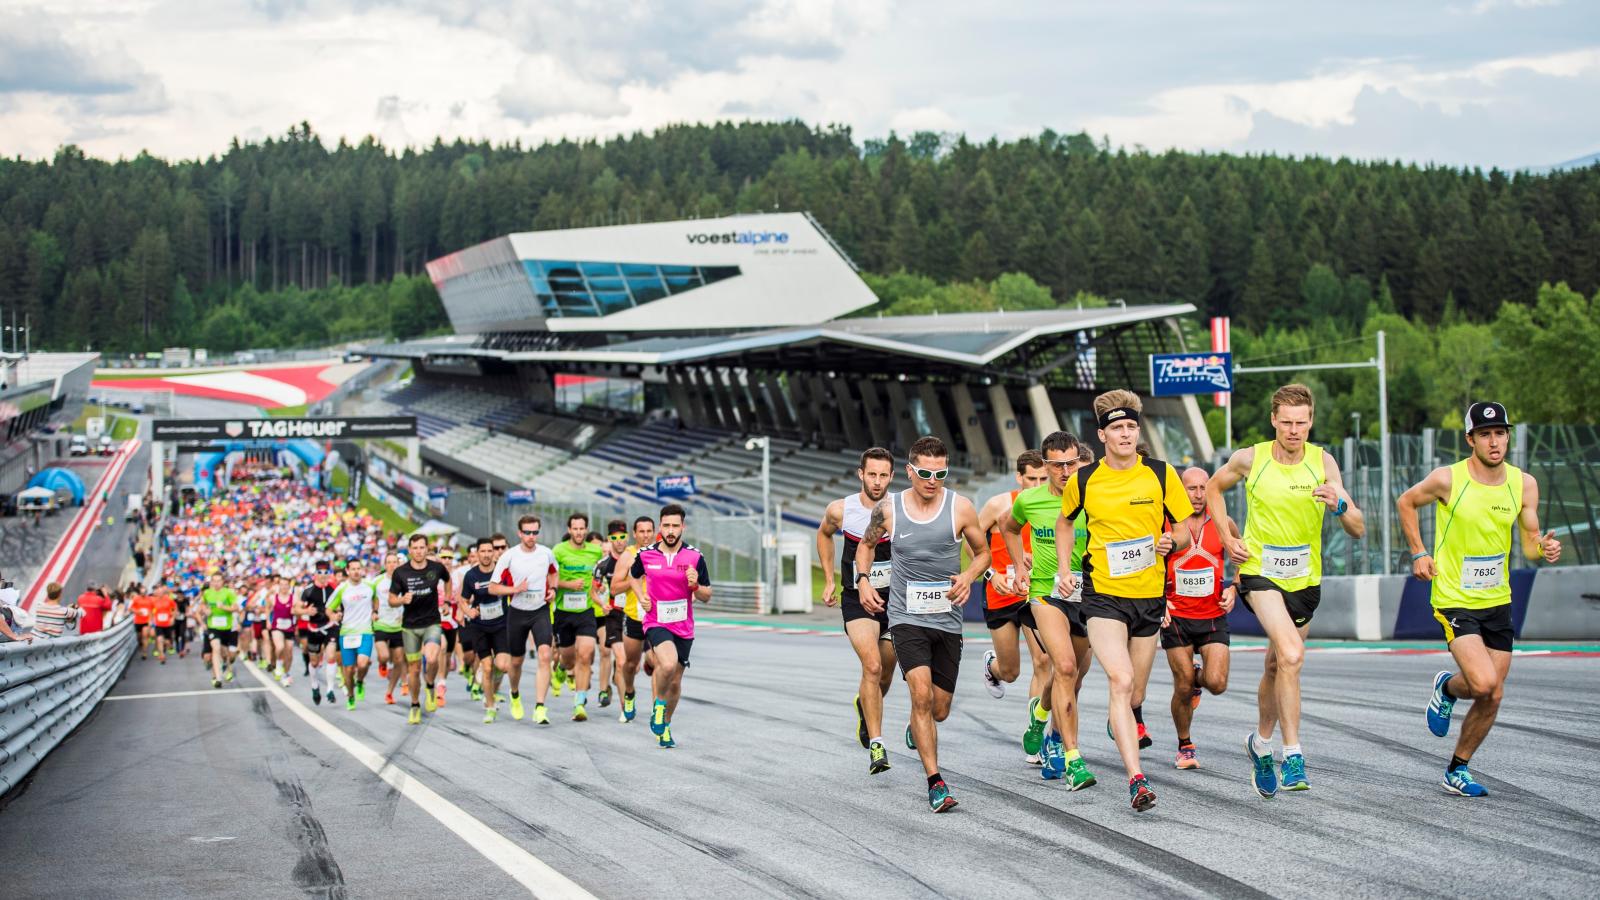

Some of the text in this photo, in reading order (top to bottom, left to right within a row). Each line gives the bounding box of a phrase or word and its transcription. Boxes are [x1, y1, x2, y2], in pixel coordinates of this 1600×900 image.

[686, 230, 789, 245] voestalpine
[1121, 548, 1142, 561] 284
[1273, 558, 1298, 567] 763B
[1473, 567, 1496, 577] 763C
[1183, 577, 1206, 585] 683B
[916, 591, 941, 600] 754B
